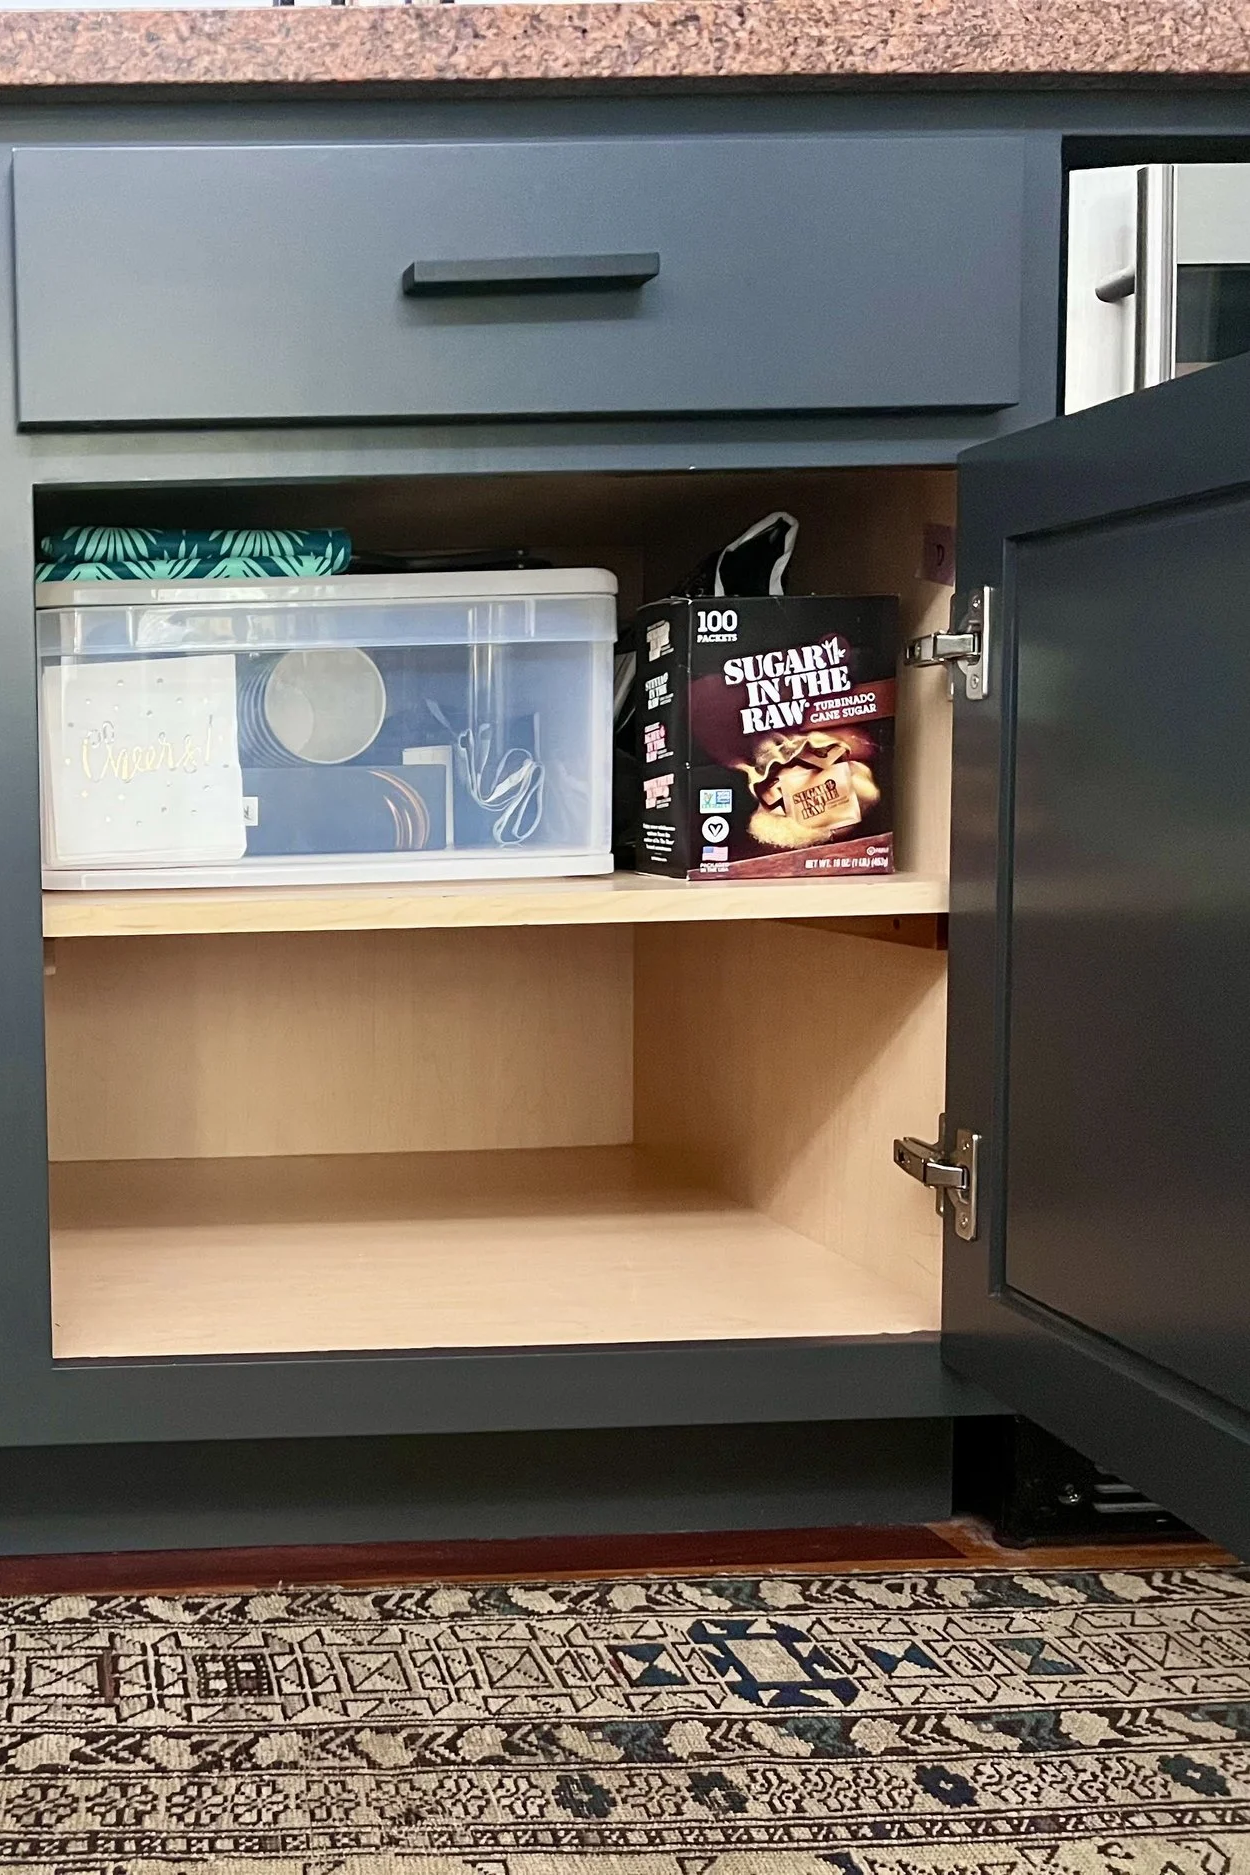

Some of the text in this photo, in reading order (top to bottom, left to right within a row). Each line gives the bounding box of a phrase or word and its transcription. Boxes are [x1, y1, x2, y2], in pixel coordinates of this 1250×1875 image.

[696, 609, 738, 633] 100
[696, 633, 738, 643] PACKETS
[723, 644, 827, 686] SUGAR
[746, 665, 851, 707] IN THE
[740, 699, 807, 735] RAW
[810, 703, 877, 724] CANE SUGAR
[813, 692, 876, 712] TURBINADO
[82, 714, 213, 783] Cheers!
